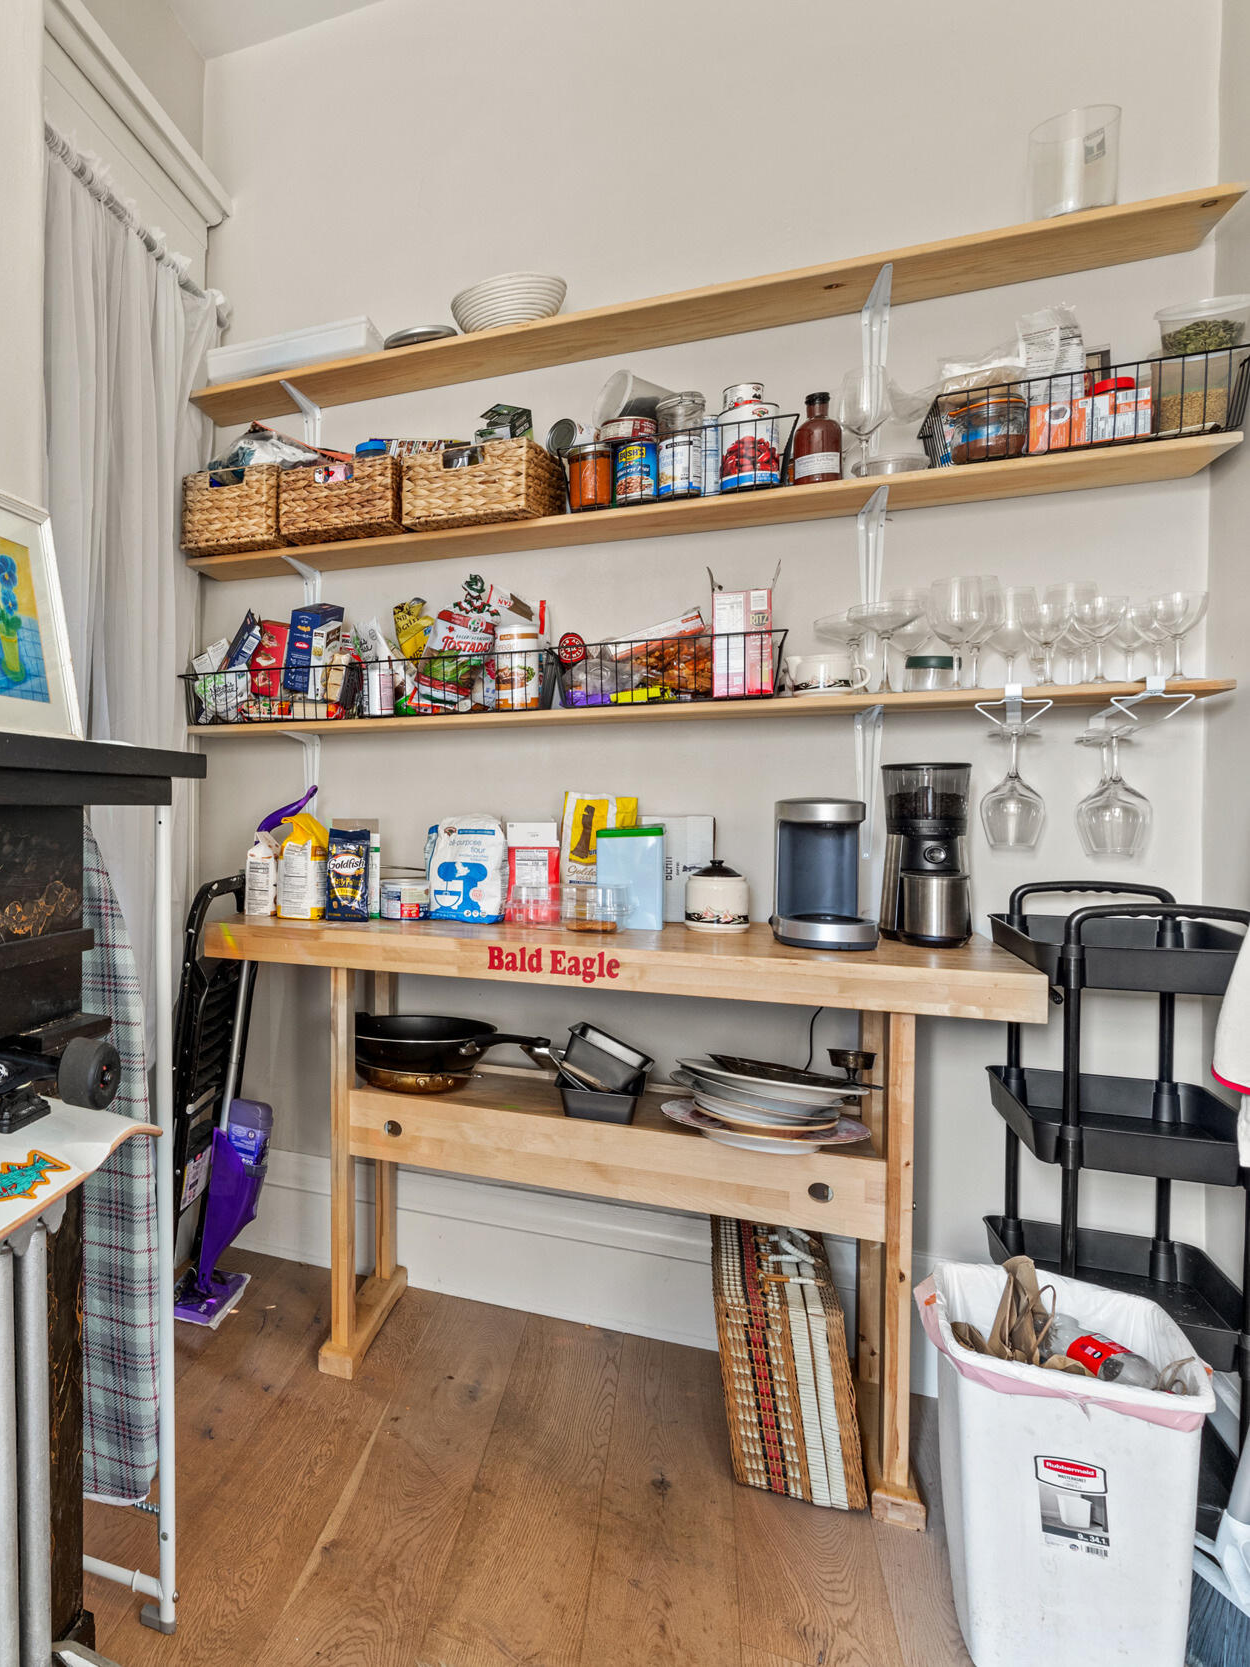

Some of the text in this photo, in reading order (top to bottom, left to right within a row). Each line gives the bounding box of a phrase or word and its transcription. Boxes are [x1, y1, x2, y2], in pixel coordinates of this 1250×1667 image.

[750, 614, 768, 625] RITZ
[441, 635, 493, 653] TOSTADAS
[328, 857, 365, 870] Goldfish
[566, 865, 597, 877] Golde
[488, 946, 620, 983] Bald Eagle
[1045, 1461, 1095, 1476] Rubbermaid
